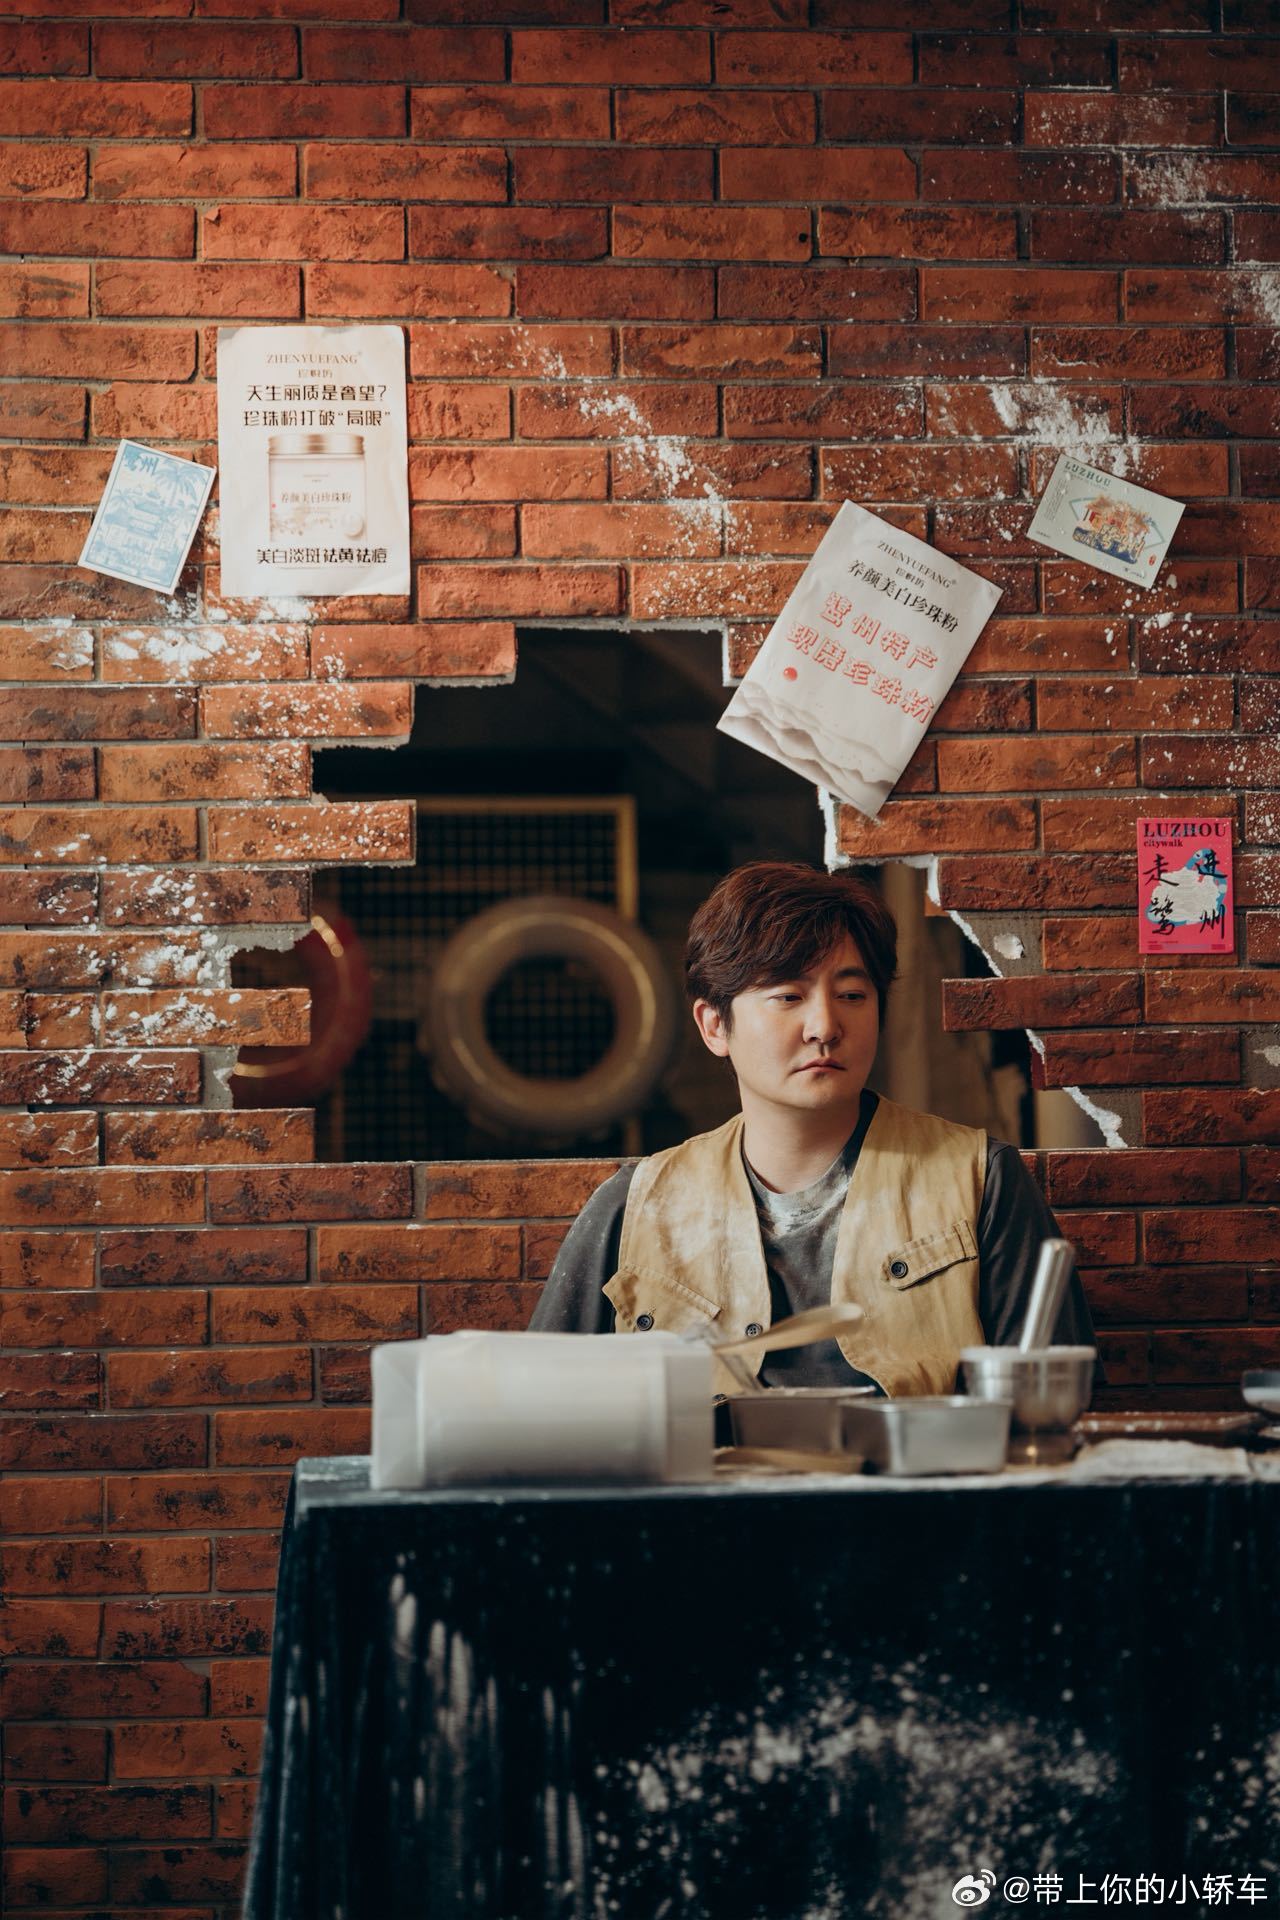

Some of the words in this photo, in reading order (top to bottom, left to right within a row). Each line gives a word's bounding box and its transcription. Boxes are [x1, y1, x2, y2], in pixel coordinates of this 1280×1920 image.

[247, 384, 388, 402] 天生丽质是奢望?
[243, 409, 391, 427] 珍珠粉打破“局限”
[1064, 461, 1112, 487] LUZHOU
[848, 559, 959, 633] 养颜美白珍珠粉
[786, 622, 936, 724] 现磨珍珠粉
[1143, 822, 1227, 838] LUZHOU
[1143, 838, 1184, 849] citywalk
